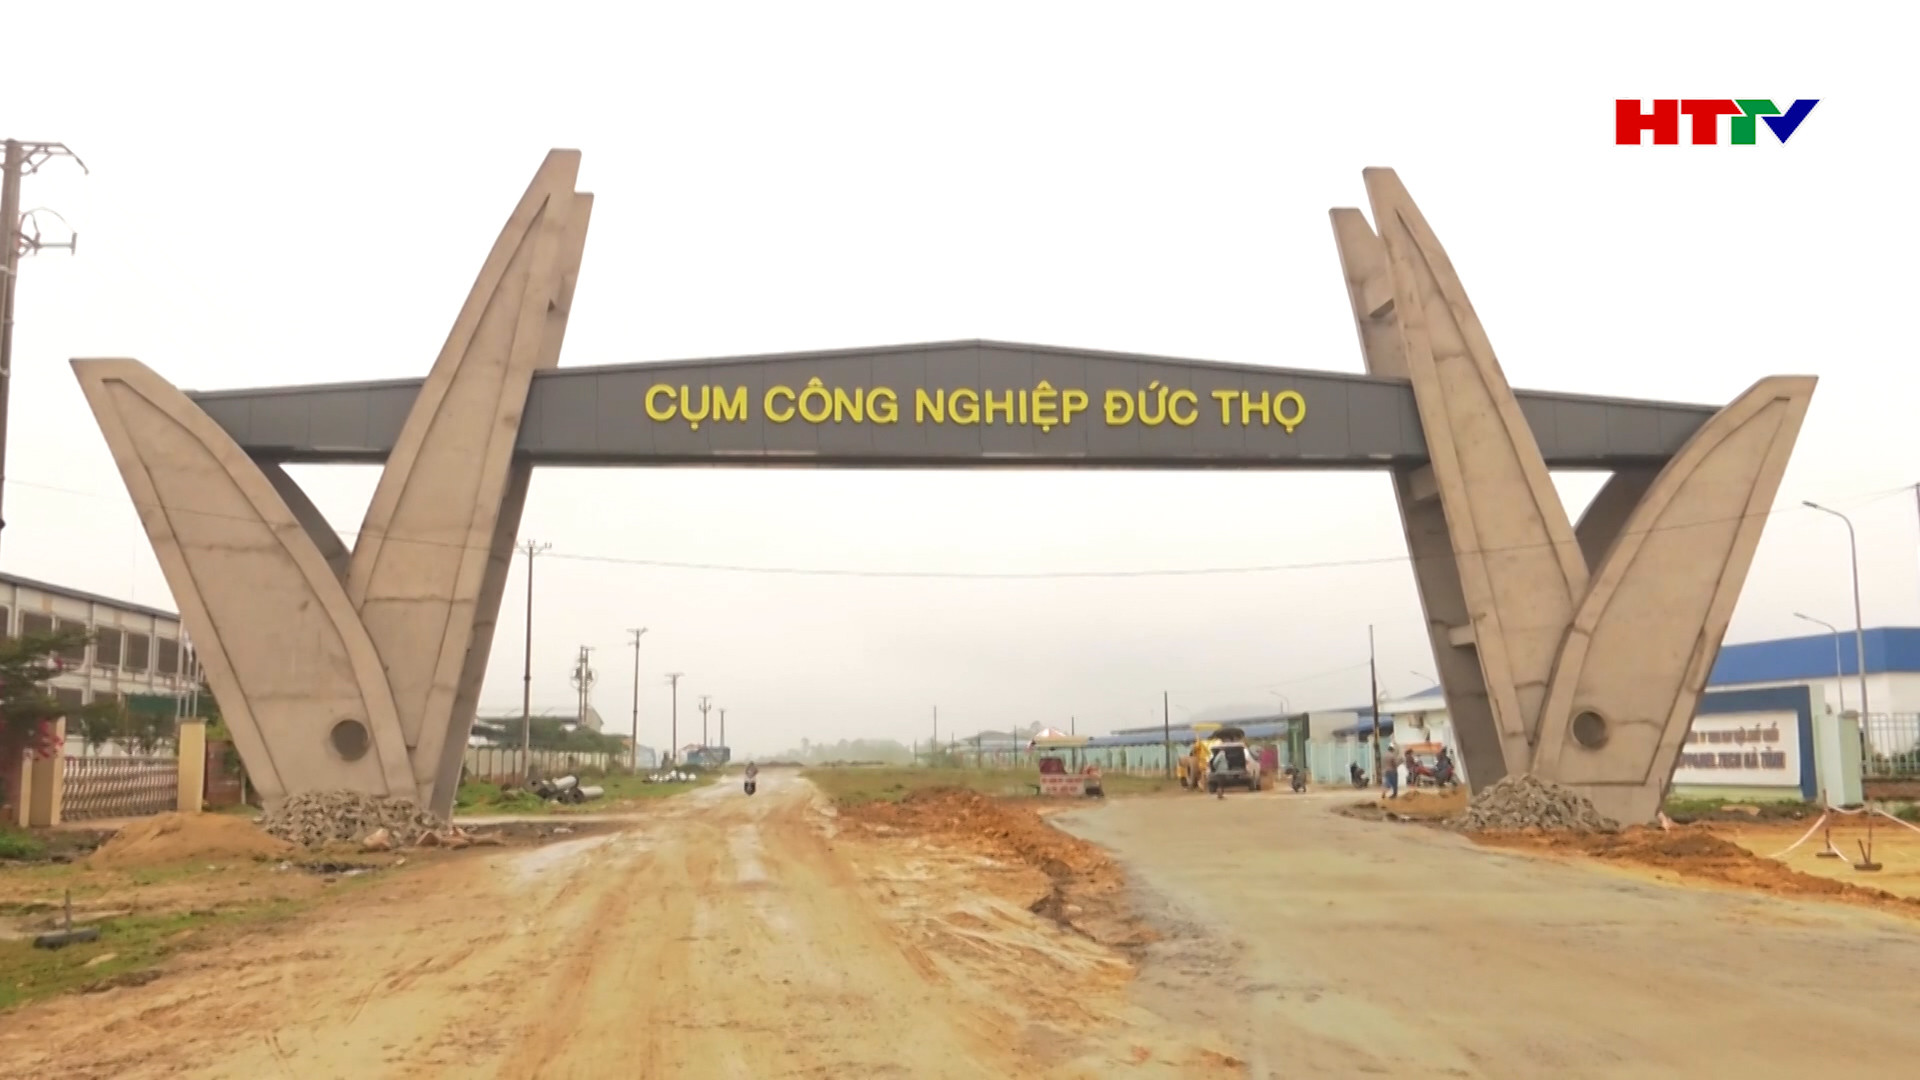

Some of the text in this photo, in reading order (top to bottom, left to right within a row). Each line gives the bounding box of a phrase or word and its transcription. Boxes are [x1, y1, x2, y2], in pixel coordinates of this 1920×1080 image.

[644, 377, 1307, 434] CỤM CÔNG NGHIỆP ĐỨC THỌ
